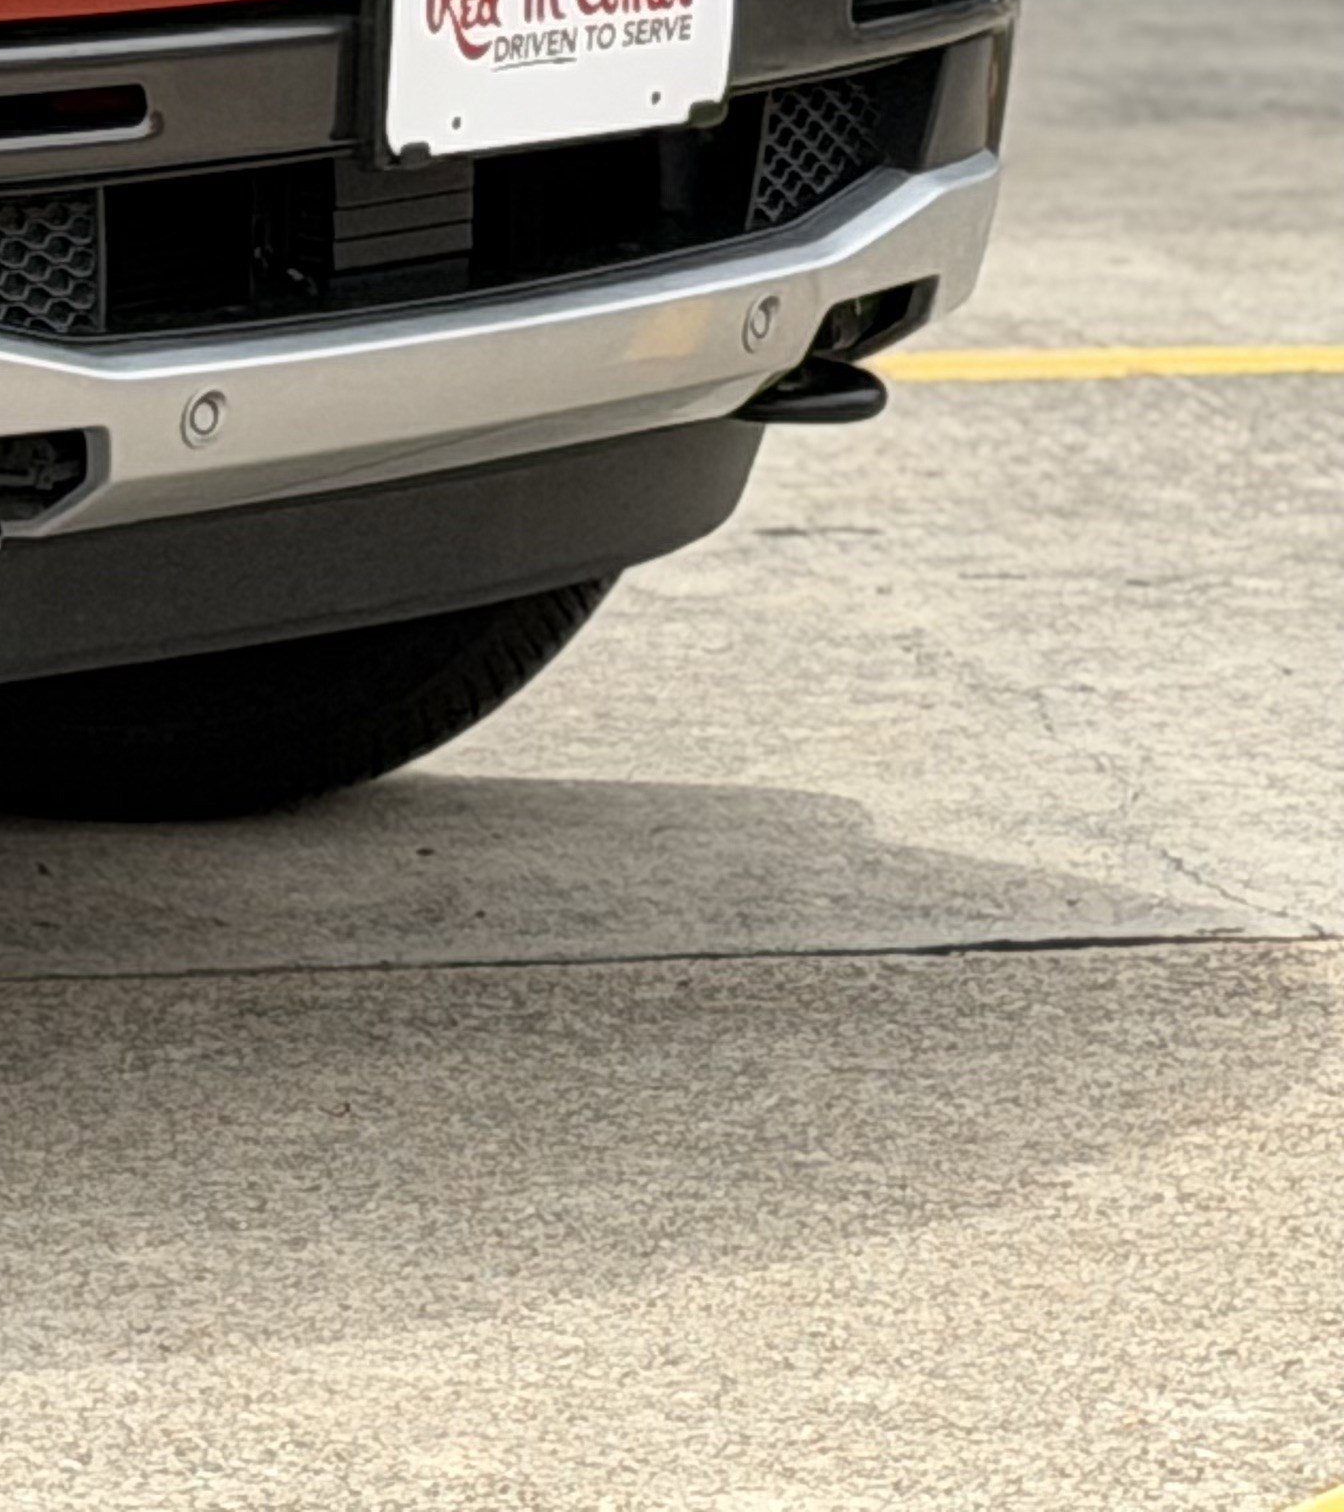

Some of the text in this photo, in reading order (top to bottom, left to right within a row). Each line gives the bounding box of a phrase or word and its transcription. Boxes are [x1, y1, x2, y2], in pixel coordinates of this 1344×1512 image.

[493, 14, 693, 63] DRIVEN TO SERVE
